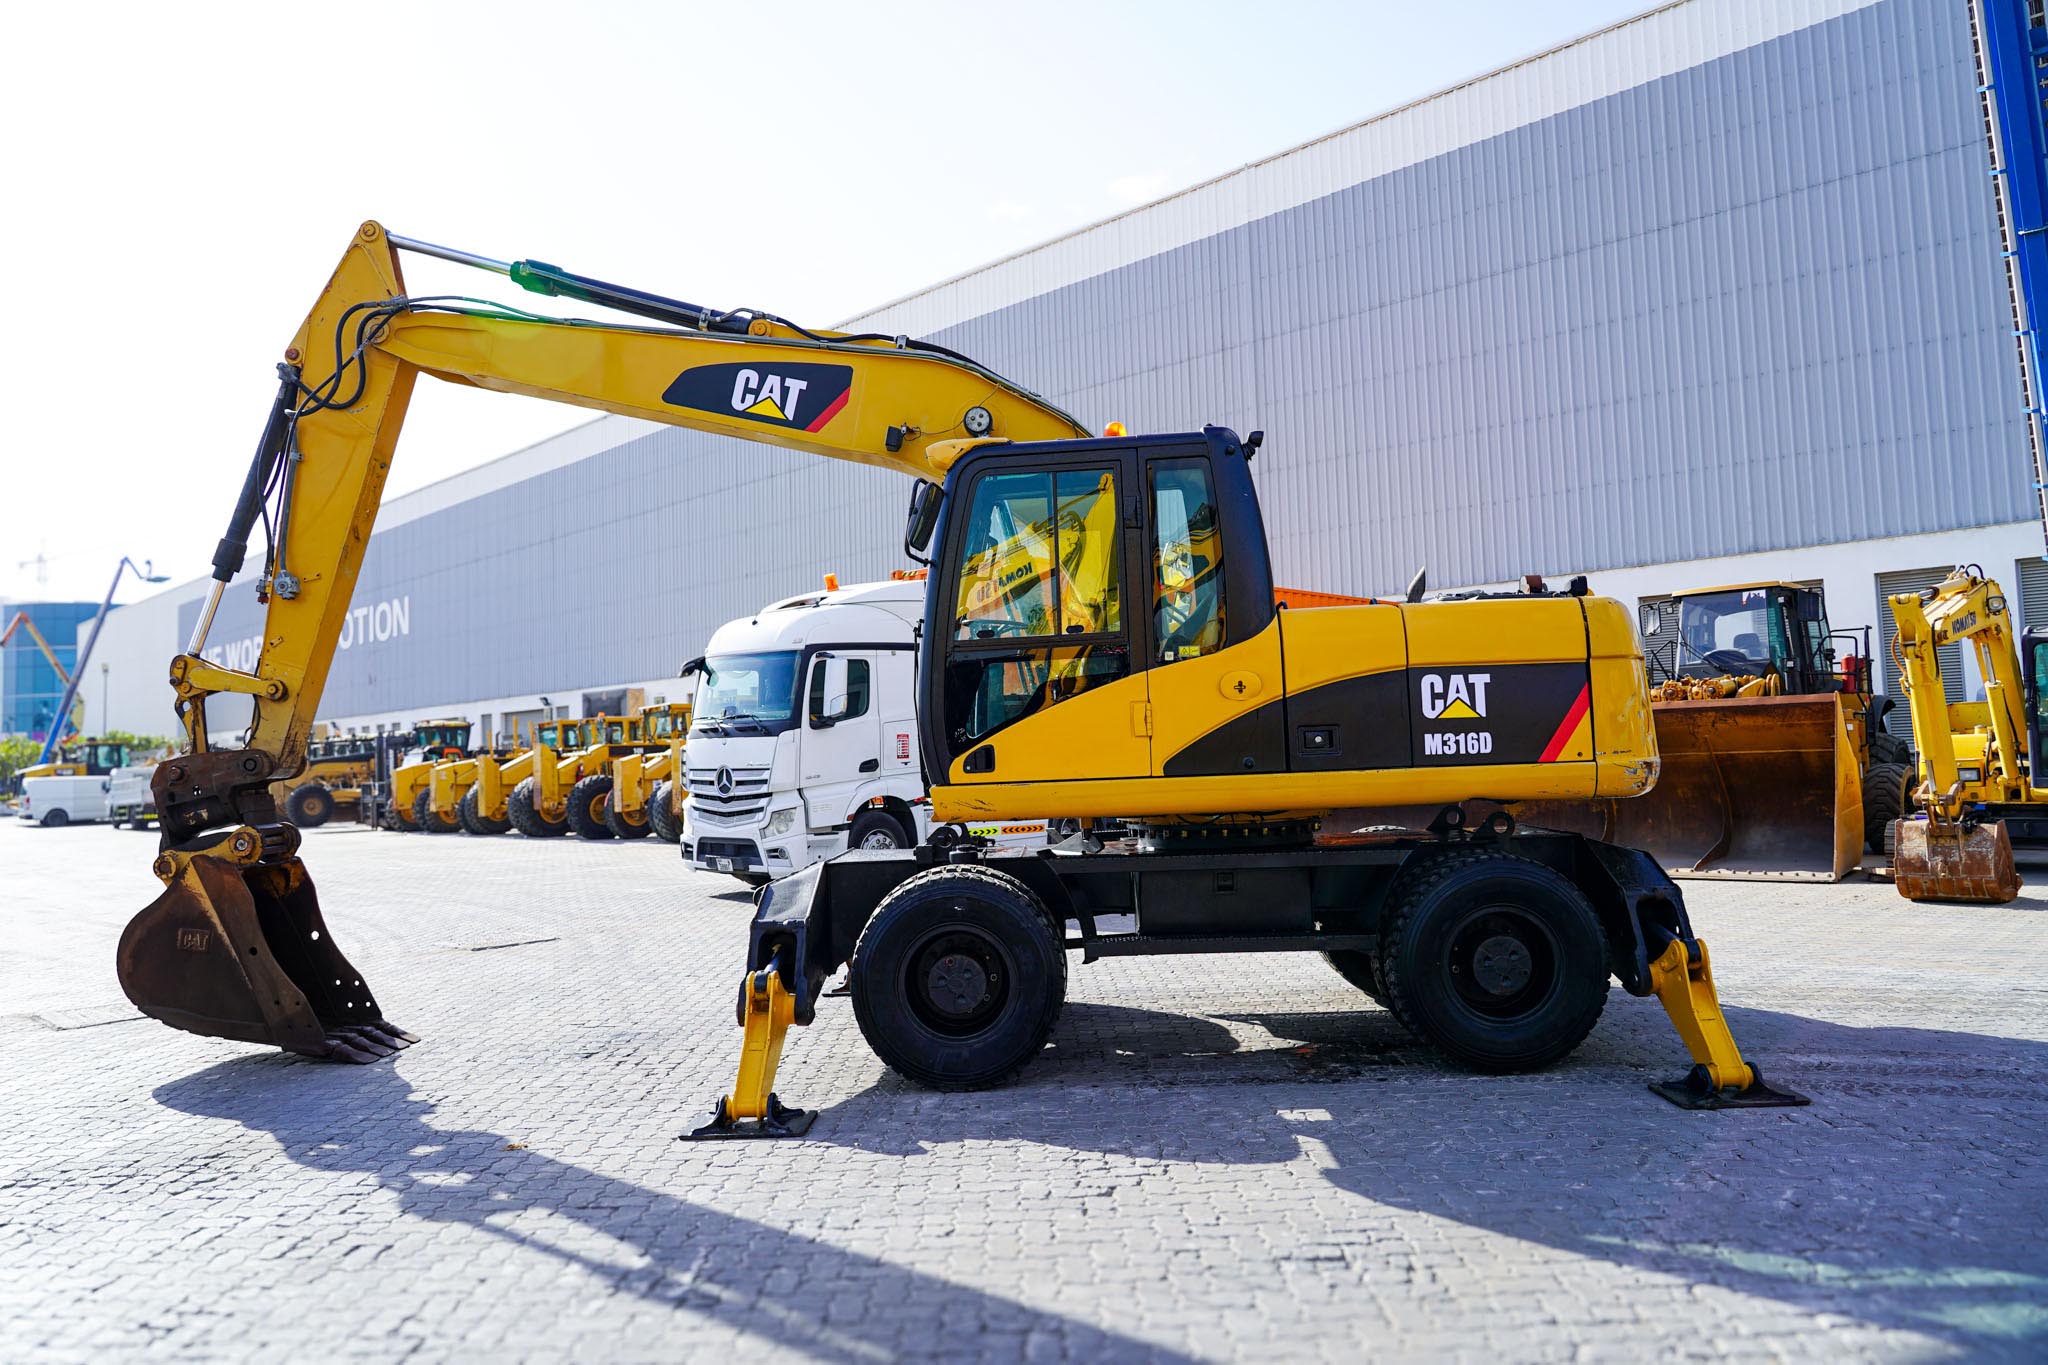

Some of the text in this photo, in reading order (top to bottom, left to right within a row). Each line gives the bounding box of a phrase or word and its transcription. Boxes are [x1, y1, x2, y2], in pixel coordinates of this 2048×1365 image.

[731, 368, 808, 421] CAT
[338, 595, 409, 650] OTION
[1951, 610, 1977, 635] KOMATSU
[1421, 673, 1491, 719] CAT
[1424, 732, 1493, 755] M316D
